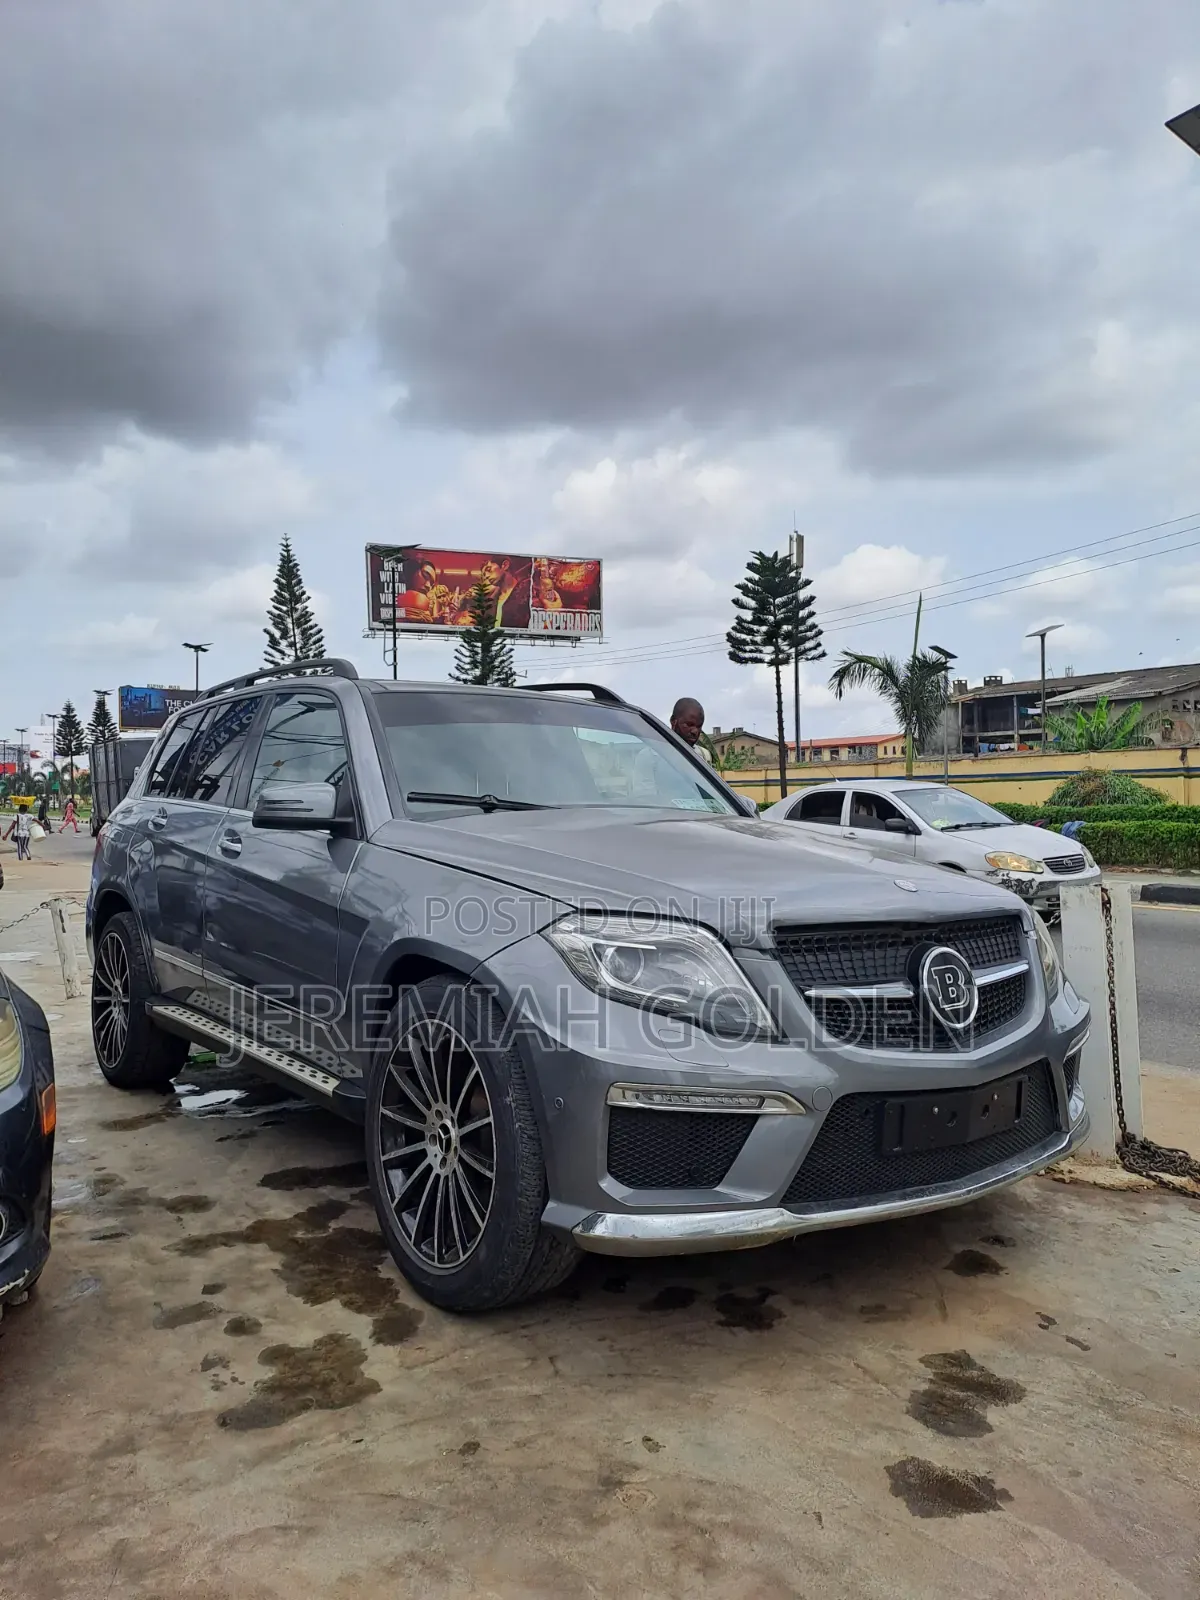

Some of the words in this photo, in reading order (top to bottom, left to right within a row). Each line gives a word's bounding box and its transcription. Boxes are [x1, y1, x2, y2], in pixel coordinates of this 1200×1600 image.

[529, 610, 601, 632] DESPERADOS
[165, 699, 182, 707] THE
[931, 965, 970, 1011] B
